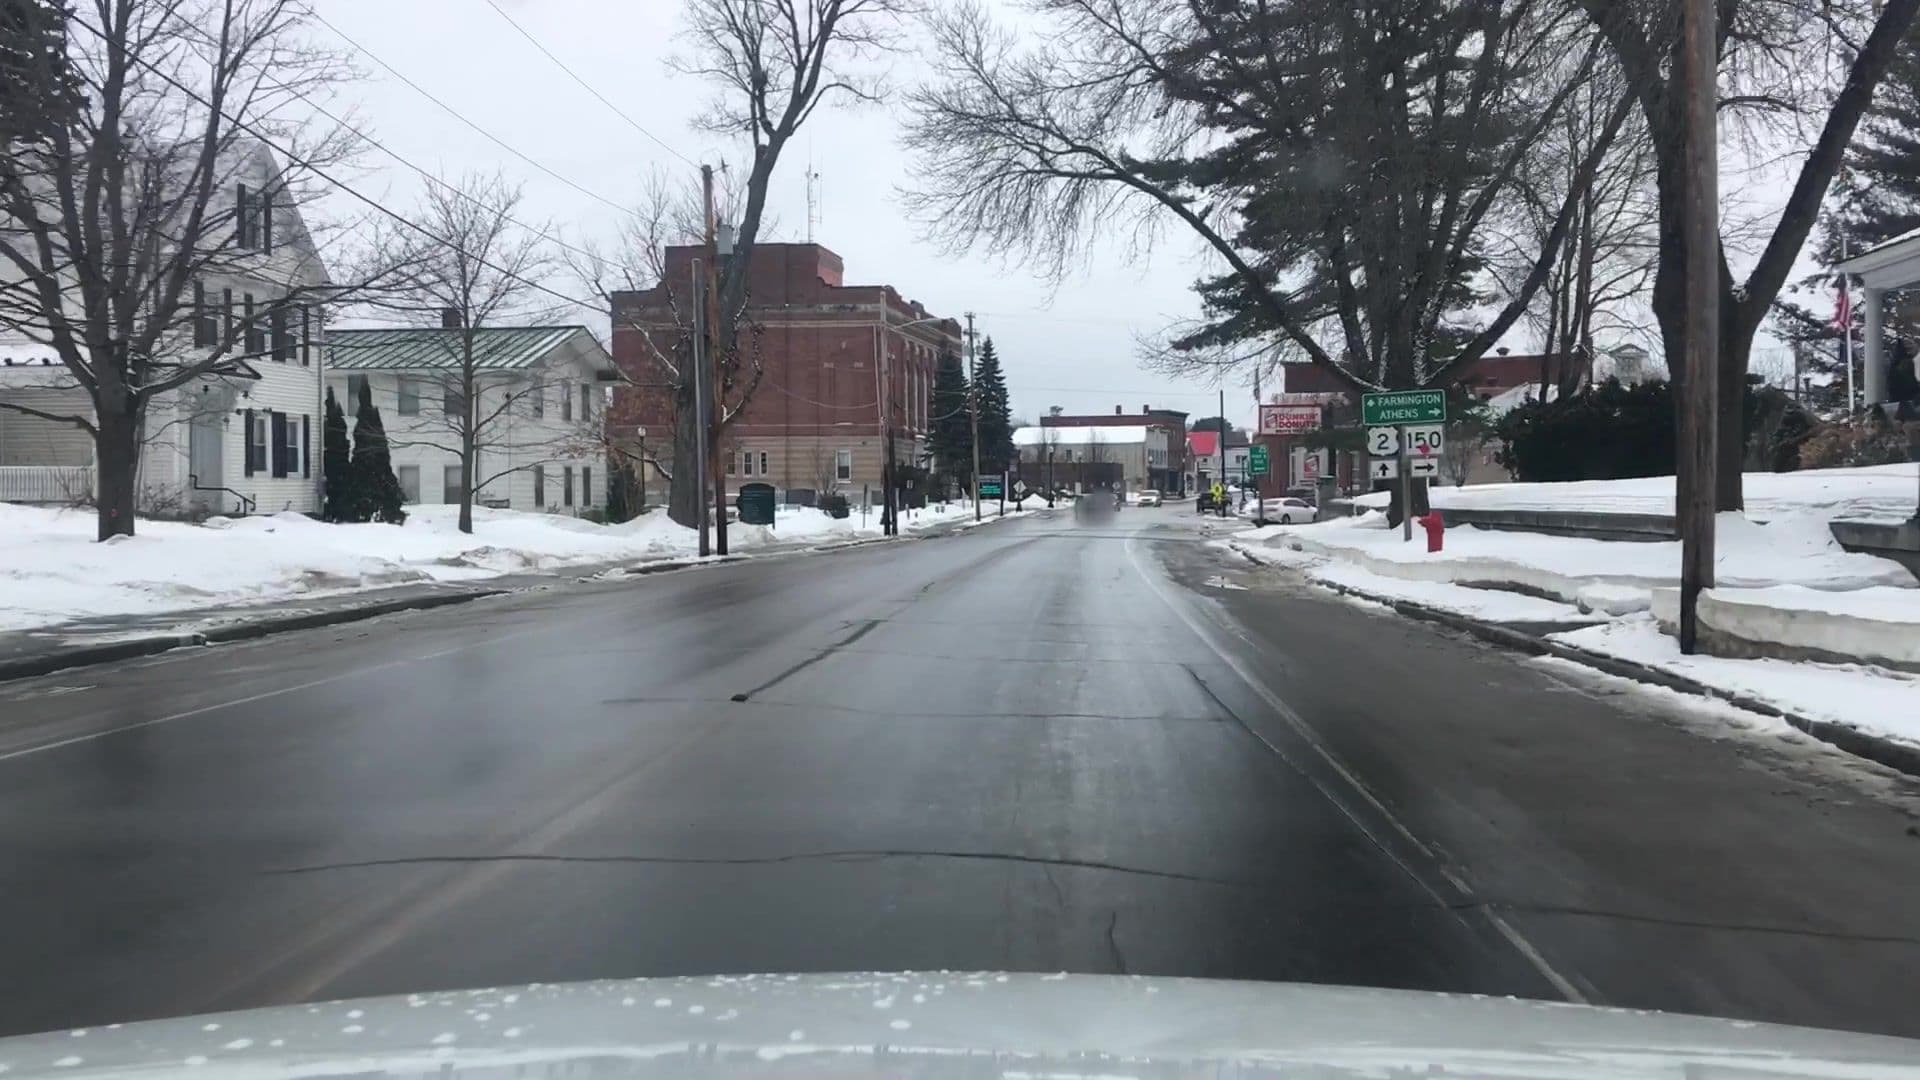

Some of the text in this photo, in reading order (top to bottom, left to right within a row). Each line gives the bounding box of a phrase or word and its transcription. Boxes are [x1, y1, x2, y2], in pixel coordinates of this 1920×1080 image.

[1378, 394, 1441, 407] FARMINGTON
[1380, 408, 1419, 420] ATHENS
[1377, 433, 1389, 450] 2
[1407, 431, 1441, 450] 150
